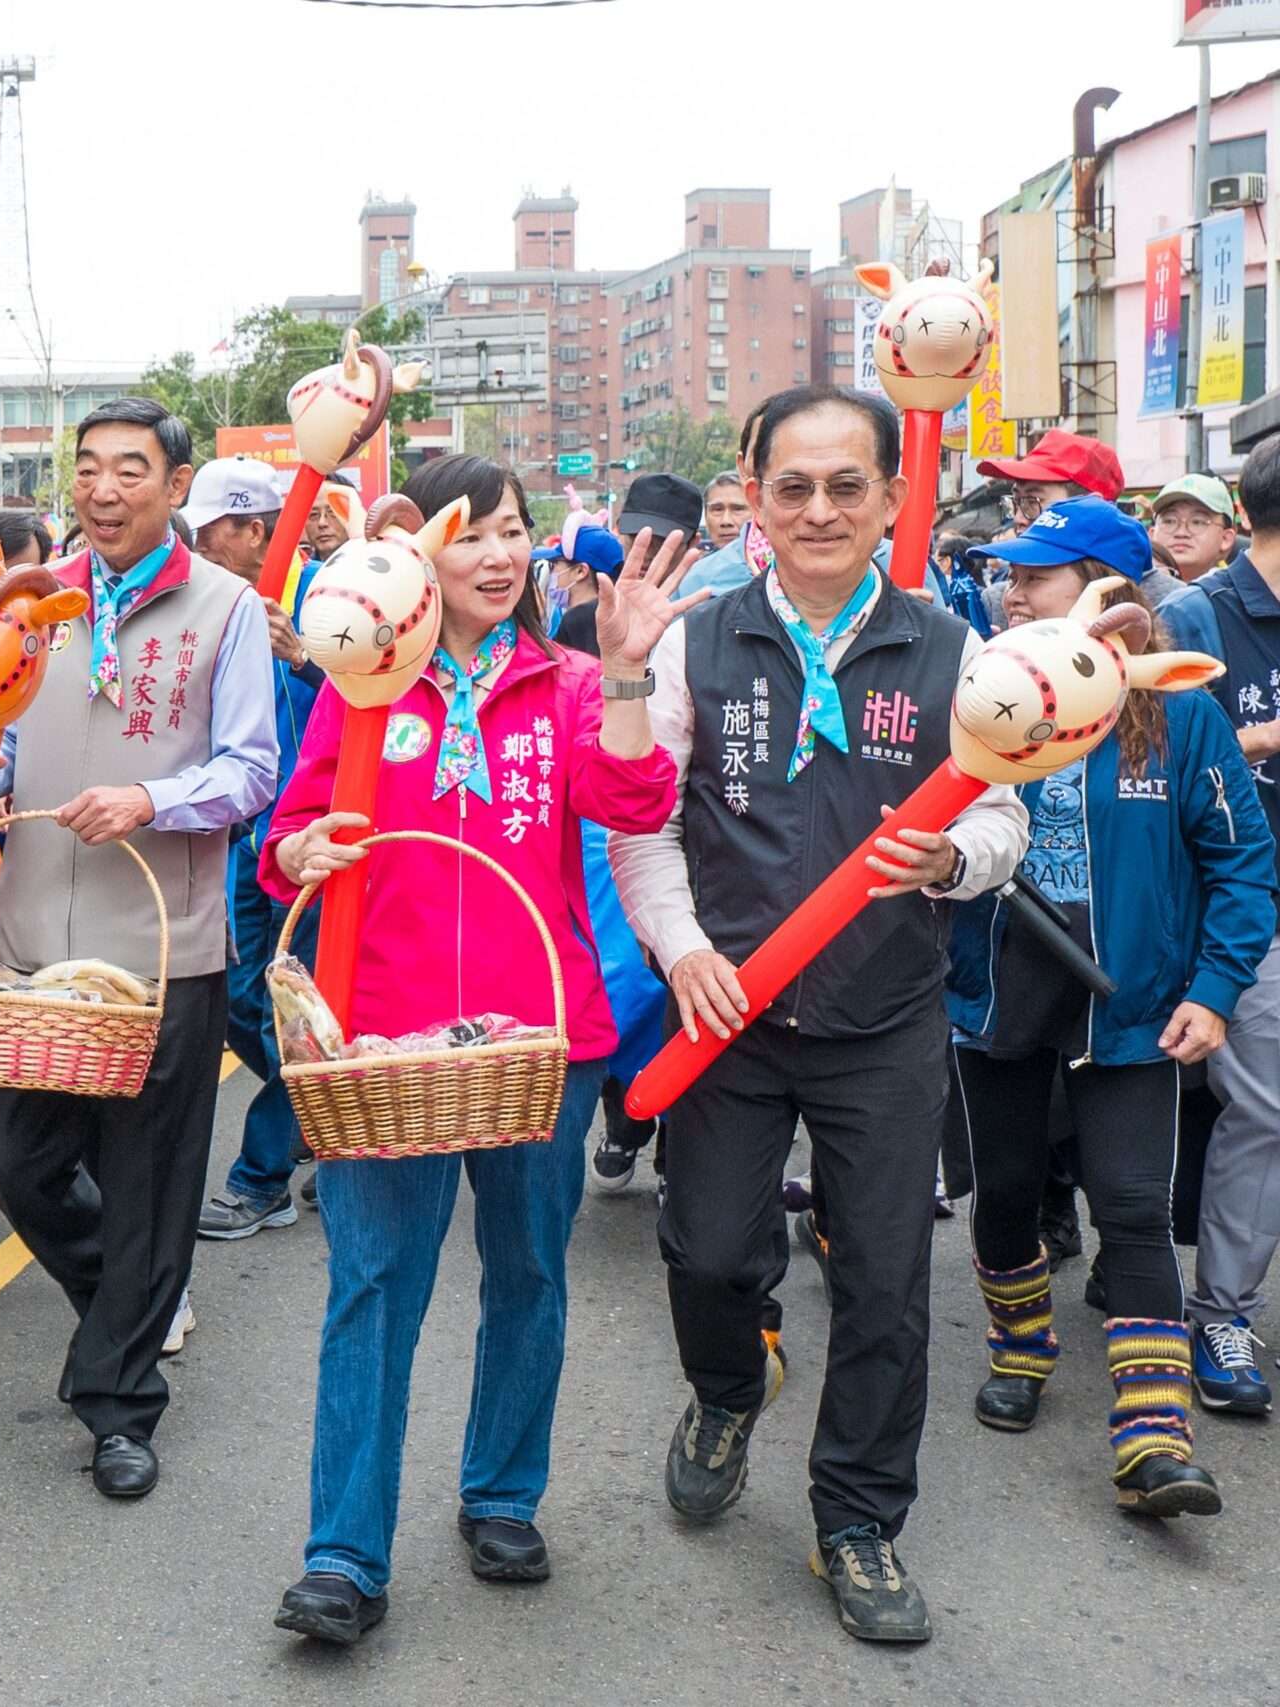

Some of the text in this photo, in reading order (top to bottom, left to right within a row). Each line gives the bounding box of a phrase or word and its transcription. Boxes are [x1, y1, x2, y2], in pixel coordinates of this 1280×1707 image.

[1212, 247, 1232, 343] 中山北
[122, 637, 163, 744] 李家興
[166, 629, 200, 730] 桃園市議員
[752, 677, 770, 764] 楊梅區長
[500, 732, 535, 844] 鄭淑方
[532, 715, 556, 828] 桃園市議員
[1119, 778, 1168, 793] KMT
